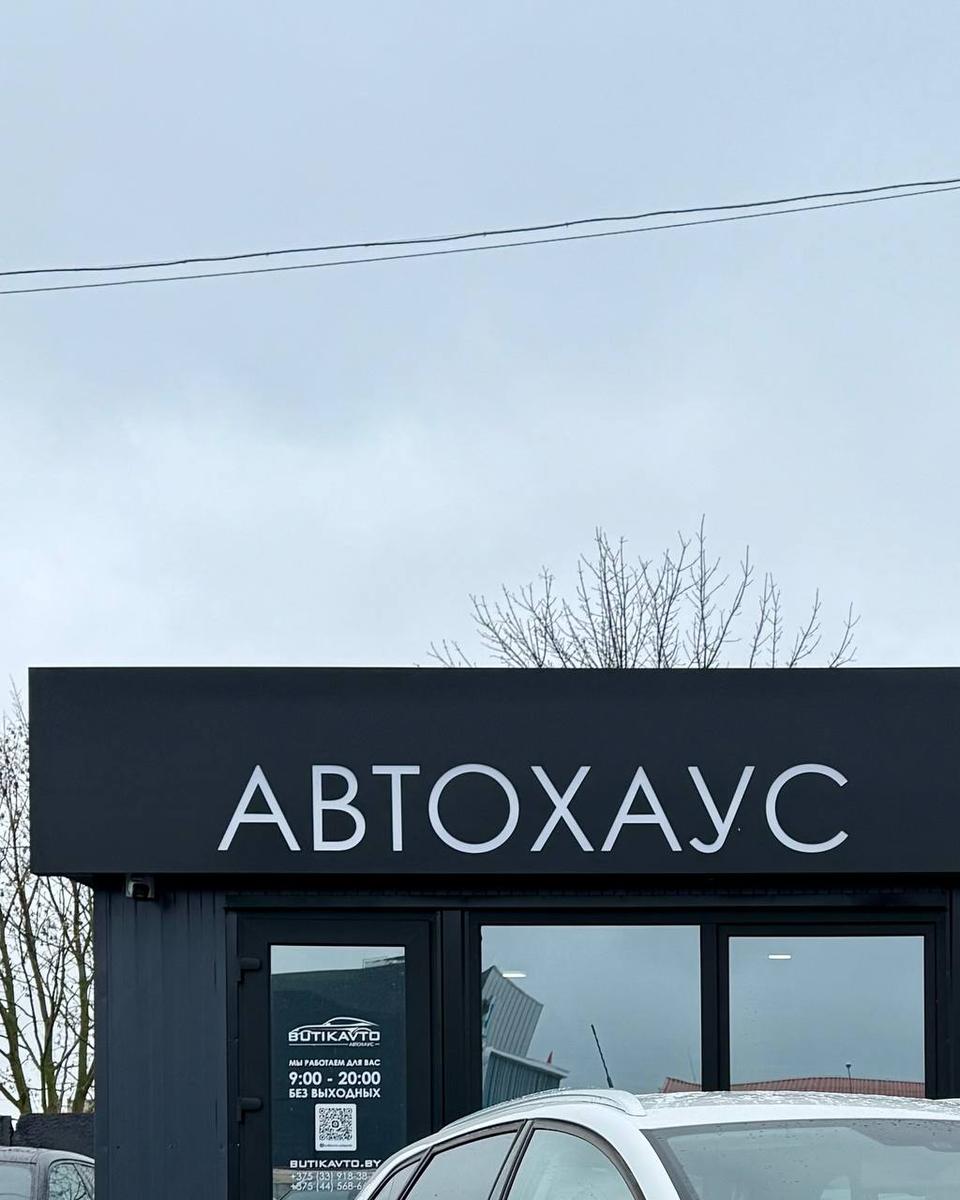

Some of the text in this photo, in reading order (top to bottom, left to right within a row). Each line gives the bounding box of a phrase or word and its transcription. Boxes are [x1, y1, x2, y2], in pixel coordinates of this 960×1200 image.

[217, 763, 850, 854] АВТОХАУС
[288, 1031, 380, 1042] BUTIKAVTO
[289, 1071, 322, 1086] 9:00
[338, 1071, 381, 1086] 20:00
[289, 1087, 381, 1099] БЕЗ ВЫХОДНЫХ
[290, 1160, 381, 1168] BUTIKAVTO.BY
[316, 1171, 333, 1182] (33)
[337, 1171, 368, 1181] 918-38
